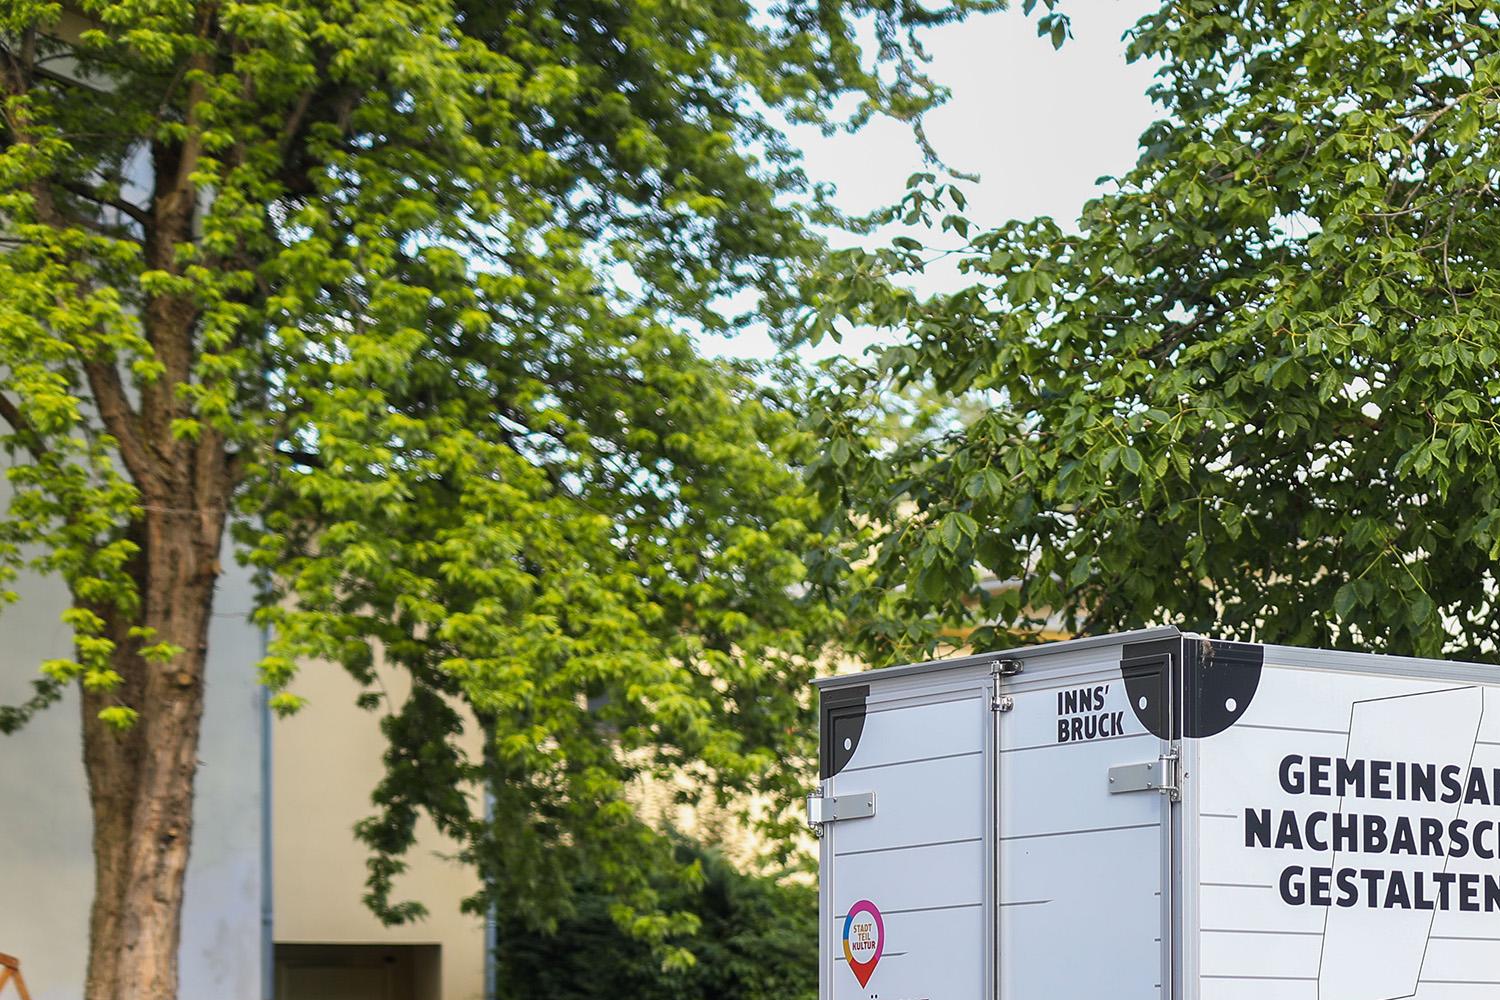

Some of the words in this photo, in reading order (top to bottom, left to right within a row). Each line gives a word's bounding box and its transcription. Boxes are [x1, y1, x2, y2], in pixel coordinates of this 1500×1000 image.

[1057, 684, 1109, 716] INNS'
[1057, 711, 1125, 743] BRUCK
[853, 923, 872, 934] STADT
[858, 932, 871, 942] TEIL
[852, 940, 876, 951] KULTUR
